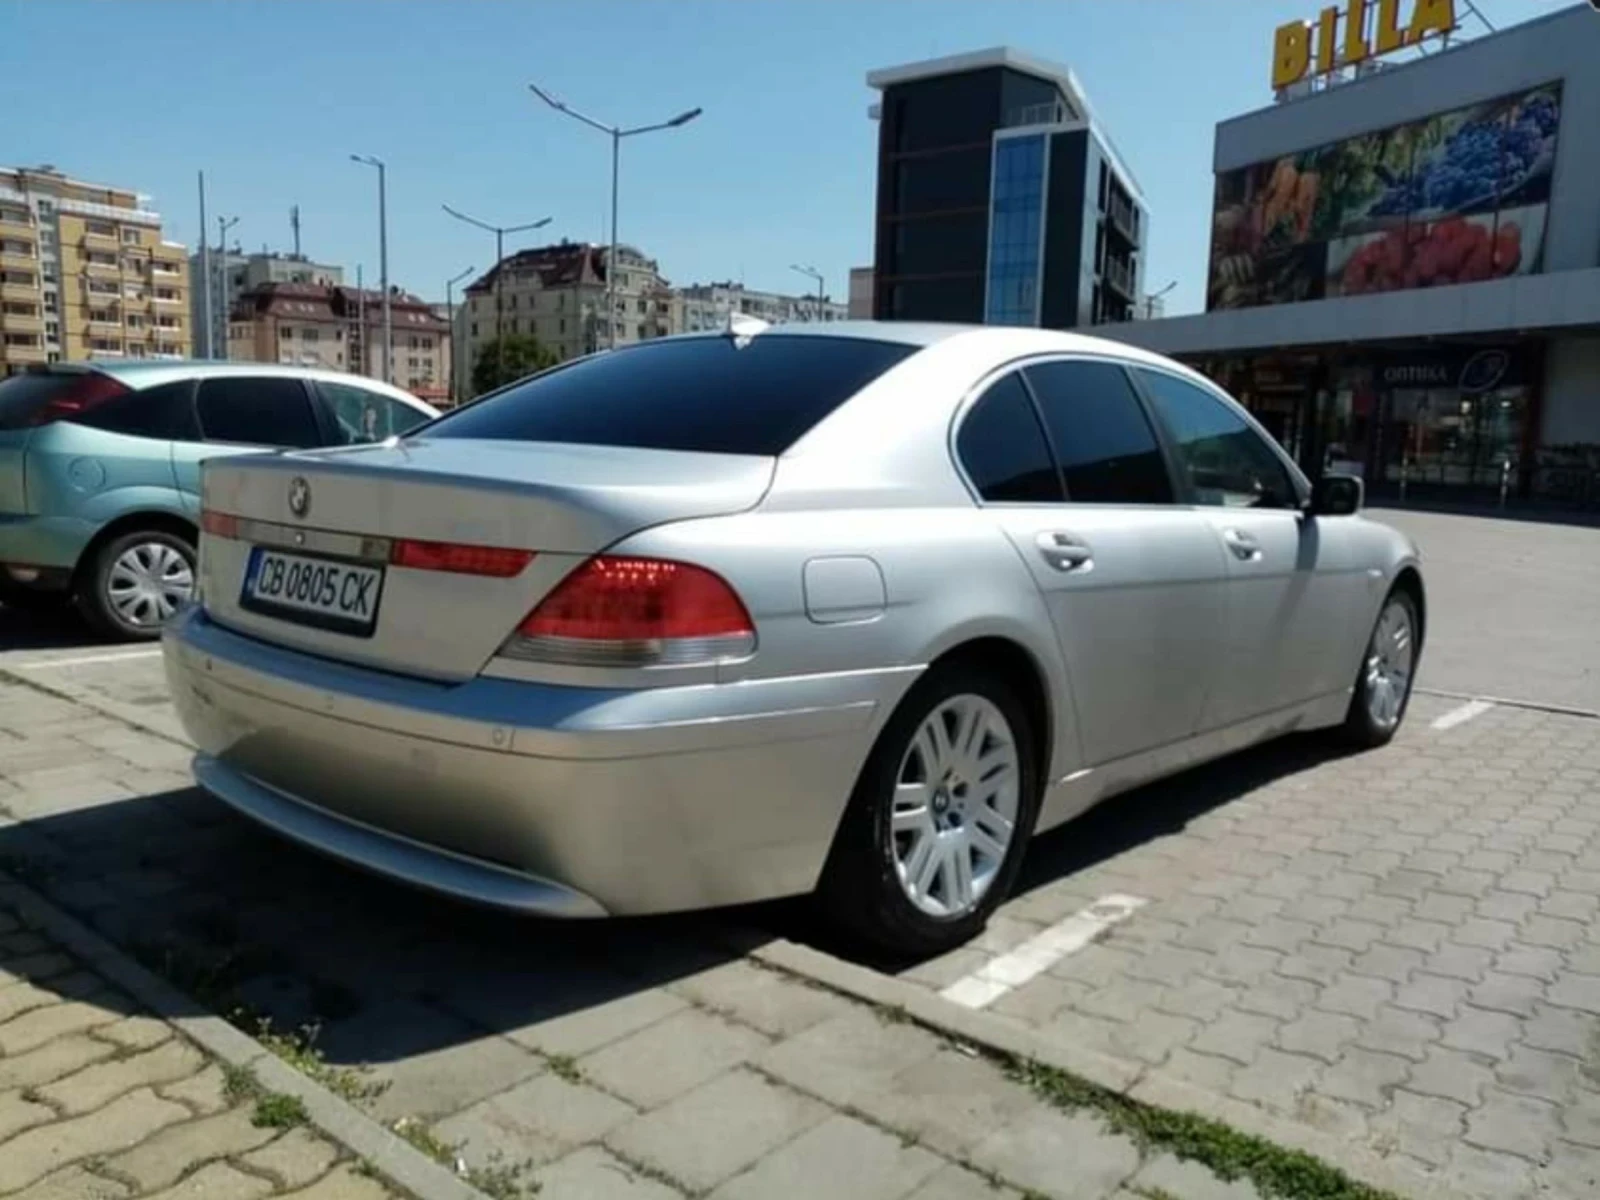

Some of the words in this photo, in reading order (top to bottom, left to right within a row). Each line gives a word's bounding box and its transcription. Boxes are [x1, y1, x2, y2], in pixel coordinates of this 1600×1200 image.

[1272, 0, 1457, 90] BILLA
[258, 556, 286, 596] CB
[285, 561, 340, 607] 0805
[339, 571, 375, 616] CK
